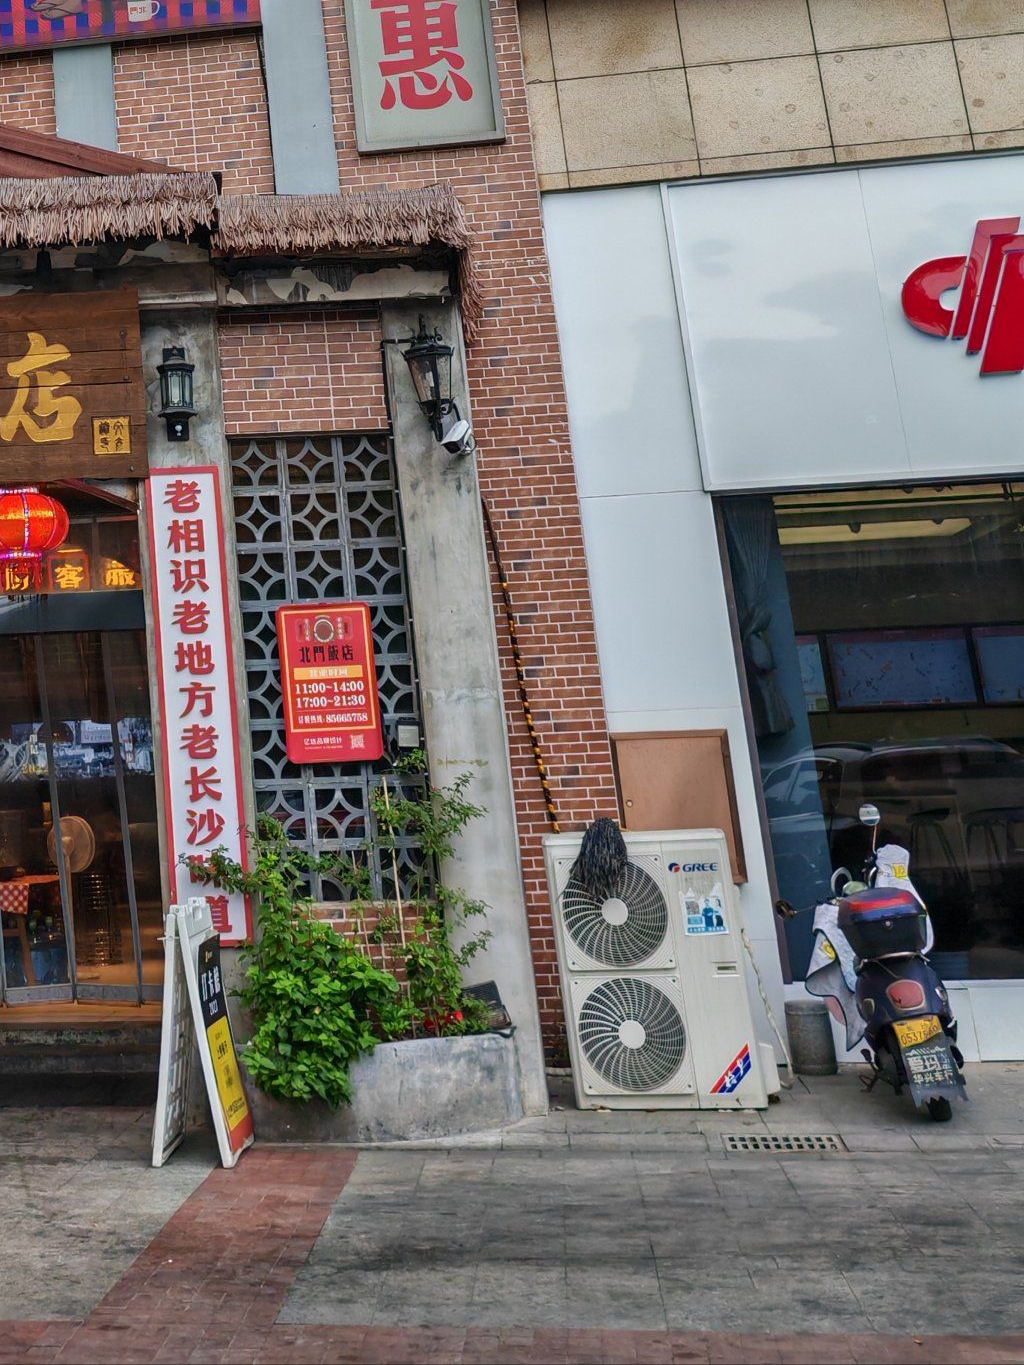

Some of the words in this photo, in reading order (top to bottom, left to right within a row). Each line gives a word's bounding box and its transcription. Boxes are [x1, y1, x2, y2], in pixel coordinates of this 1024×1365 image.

[299, 644, 354, 663] 北門飯店
[295, 680, 365, 695] 11:00~14:00
[163, 479, 233, 933] 老相识老地方老长沙味道
[296, 694, 366, 709] 17:00~21:30
[682, 862, 718, 873] GREE
